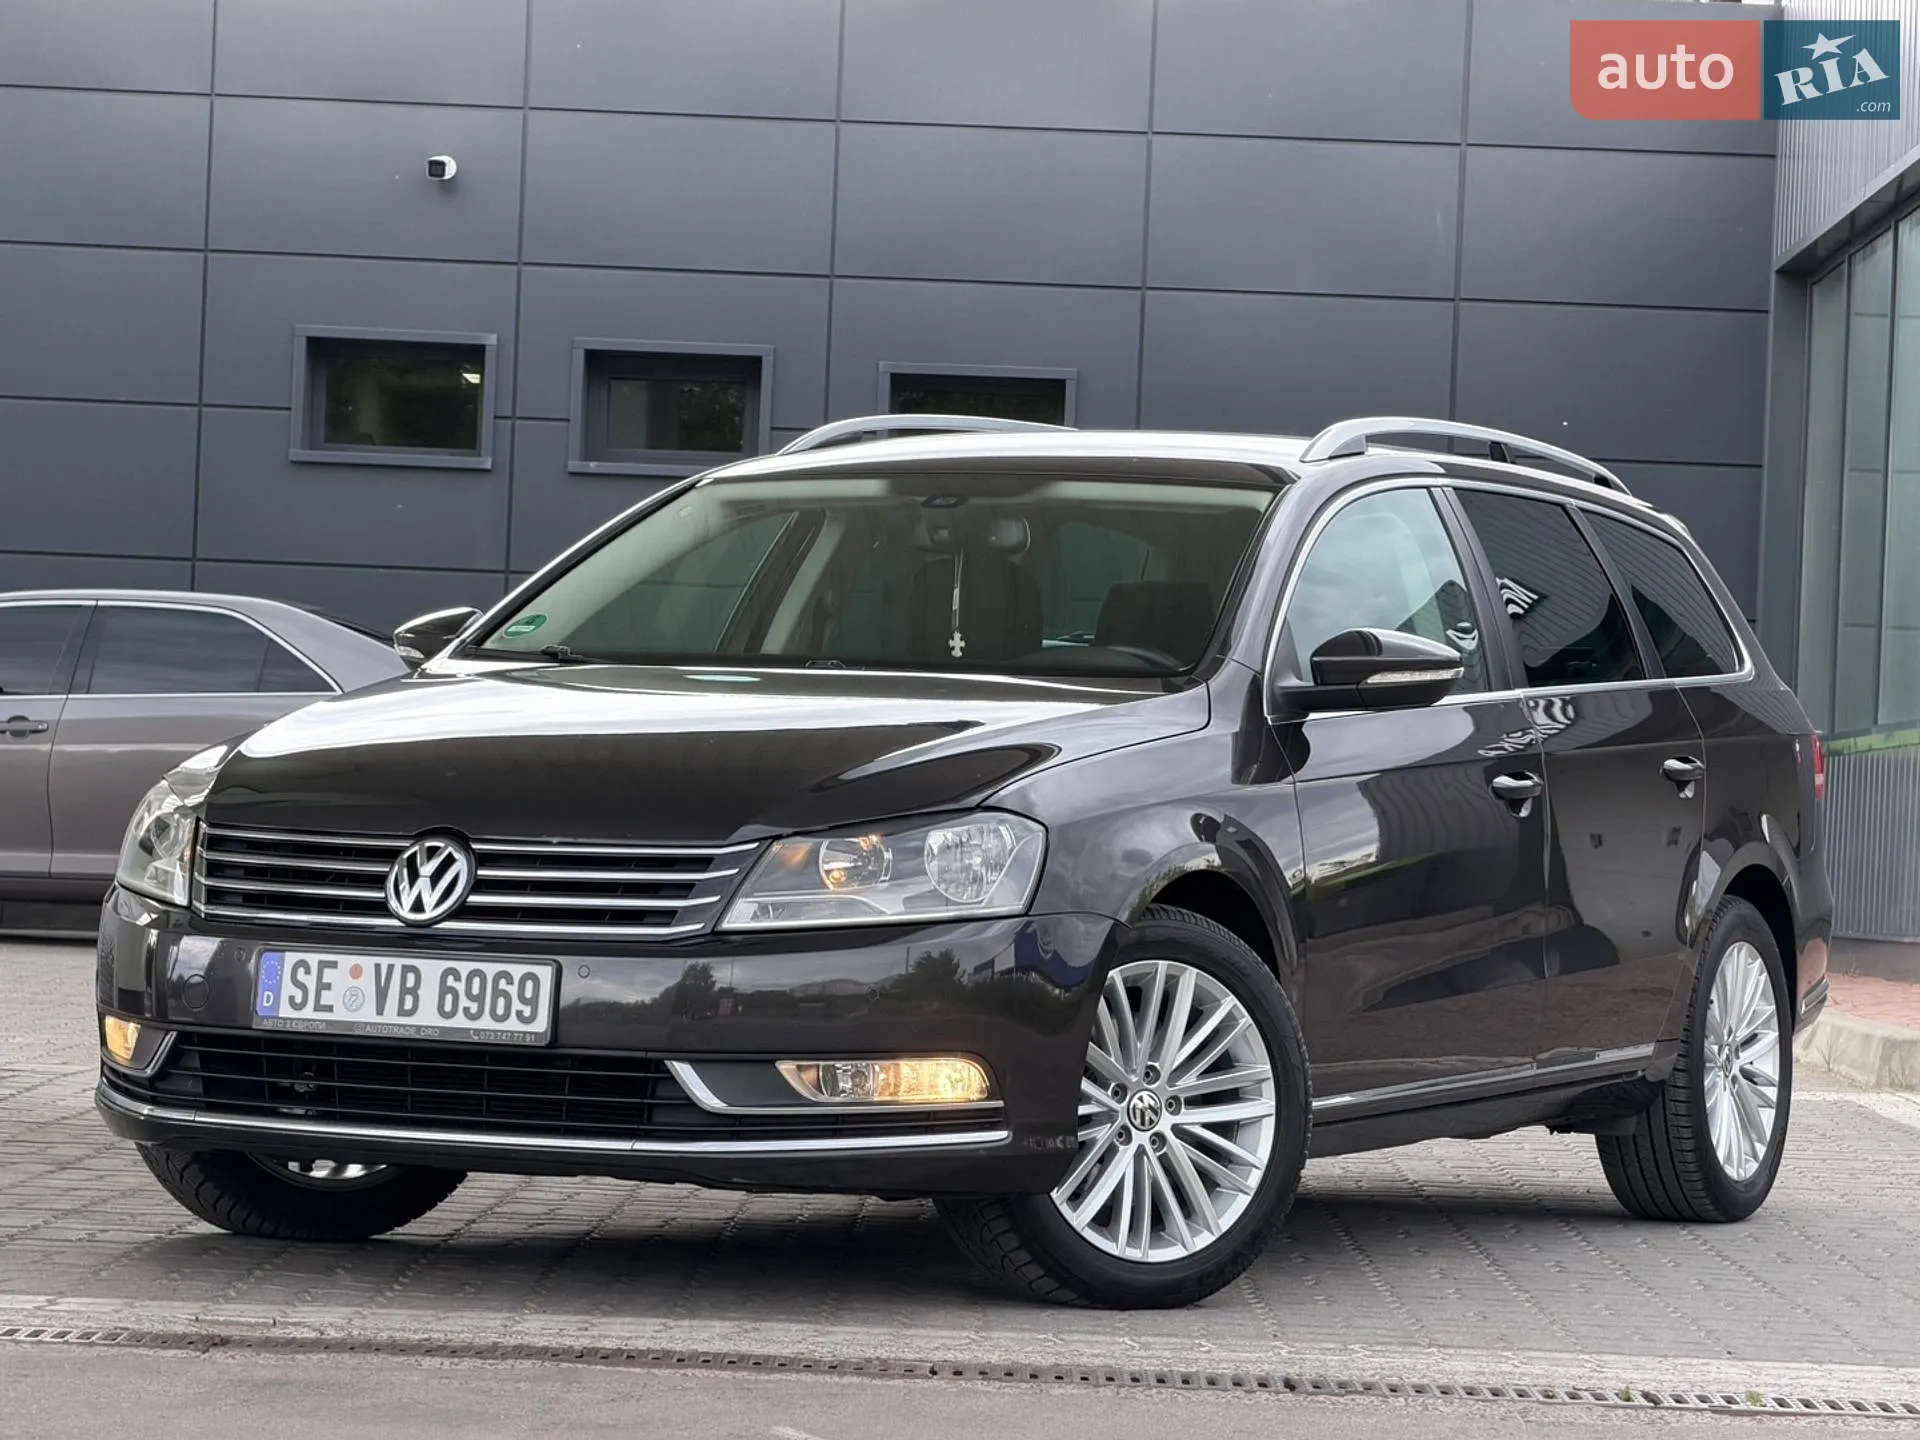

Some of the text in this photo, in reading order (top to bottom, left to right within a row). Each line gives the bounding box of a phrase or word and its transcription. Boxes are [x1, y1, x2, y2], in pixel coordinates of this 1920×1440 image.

[263, 991, 274, 1007] D
[288, 958, 541, 1025] SE VB 6969
